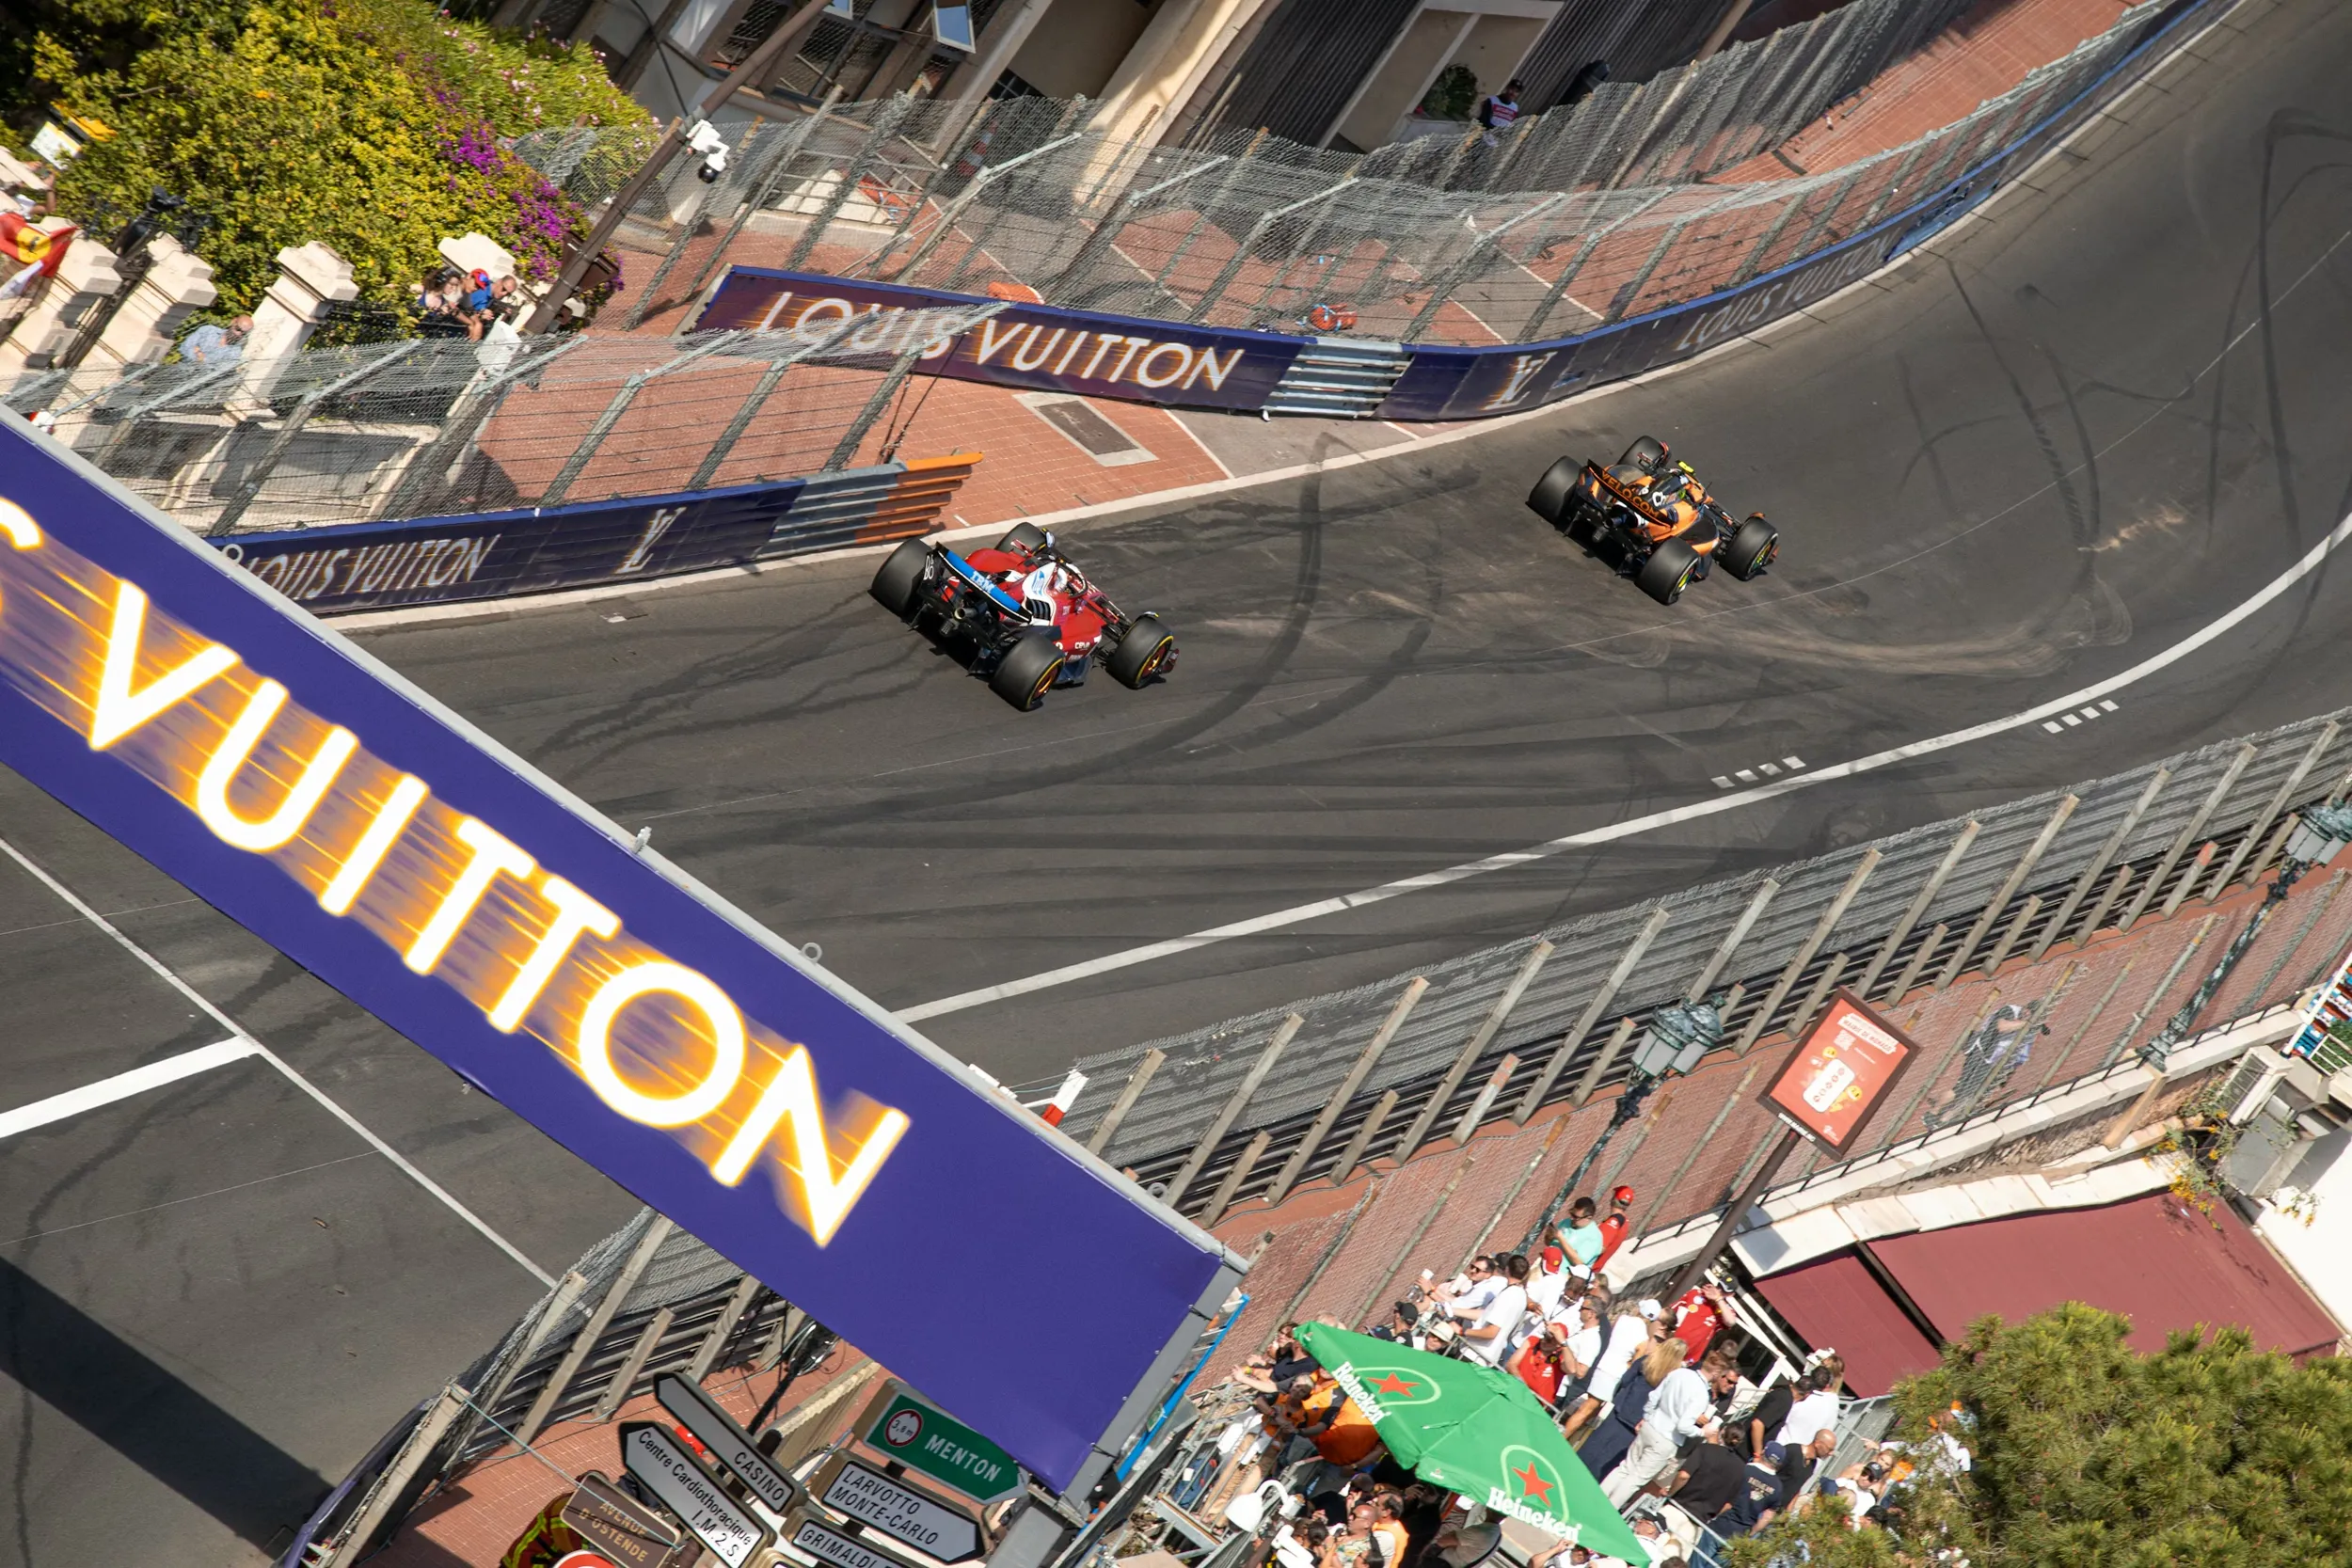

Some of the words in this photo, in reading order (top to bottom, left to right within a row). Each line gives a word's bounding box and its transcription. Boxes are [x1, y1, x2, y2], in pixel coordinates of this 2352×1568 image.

[1674, 282, 1783, 351] LOUIS
[1780, 227, 1901, 307] VUITTON
[755, 292, 964, 359] LOUIS
[977, 320, 1244, 391] VUITTON
[1601, 469, 1661, 517] VELO.COM
[342, 532, 501, 594] VUITTON
[970, 570, 995, 594] IBM
[87, 576, 912, 1248] VUITTON
[1331, 1361, 1386, 1425] Heineken
[734, 1451, 786, 1502] CASINO
[925, 1434, 1002, 1483] MENTON
[639, 1431, 673, 1467] Centre
[672, 1463, 753, 1545] Cardiothoracique
[831, 1486, 940, 1545] MONTE-CARLO
[842, 1469, 921, 1515] LARVOTTO
[1486, 1486, 1580, 1544] Heineken
[580, 1508, 649, 1562] D'OSTENDE
[599, 1501, 649, 1538] AVENUE
